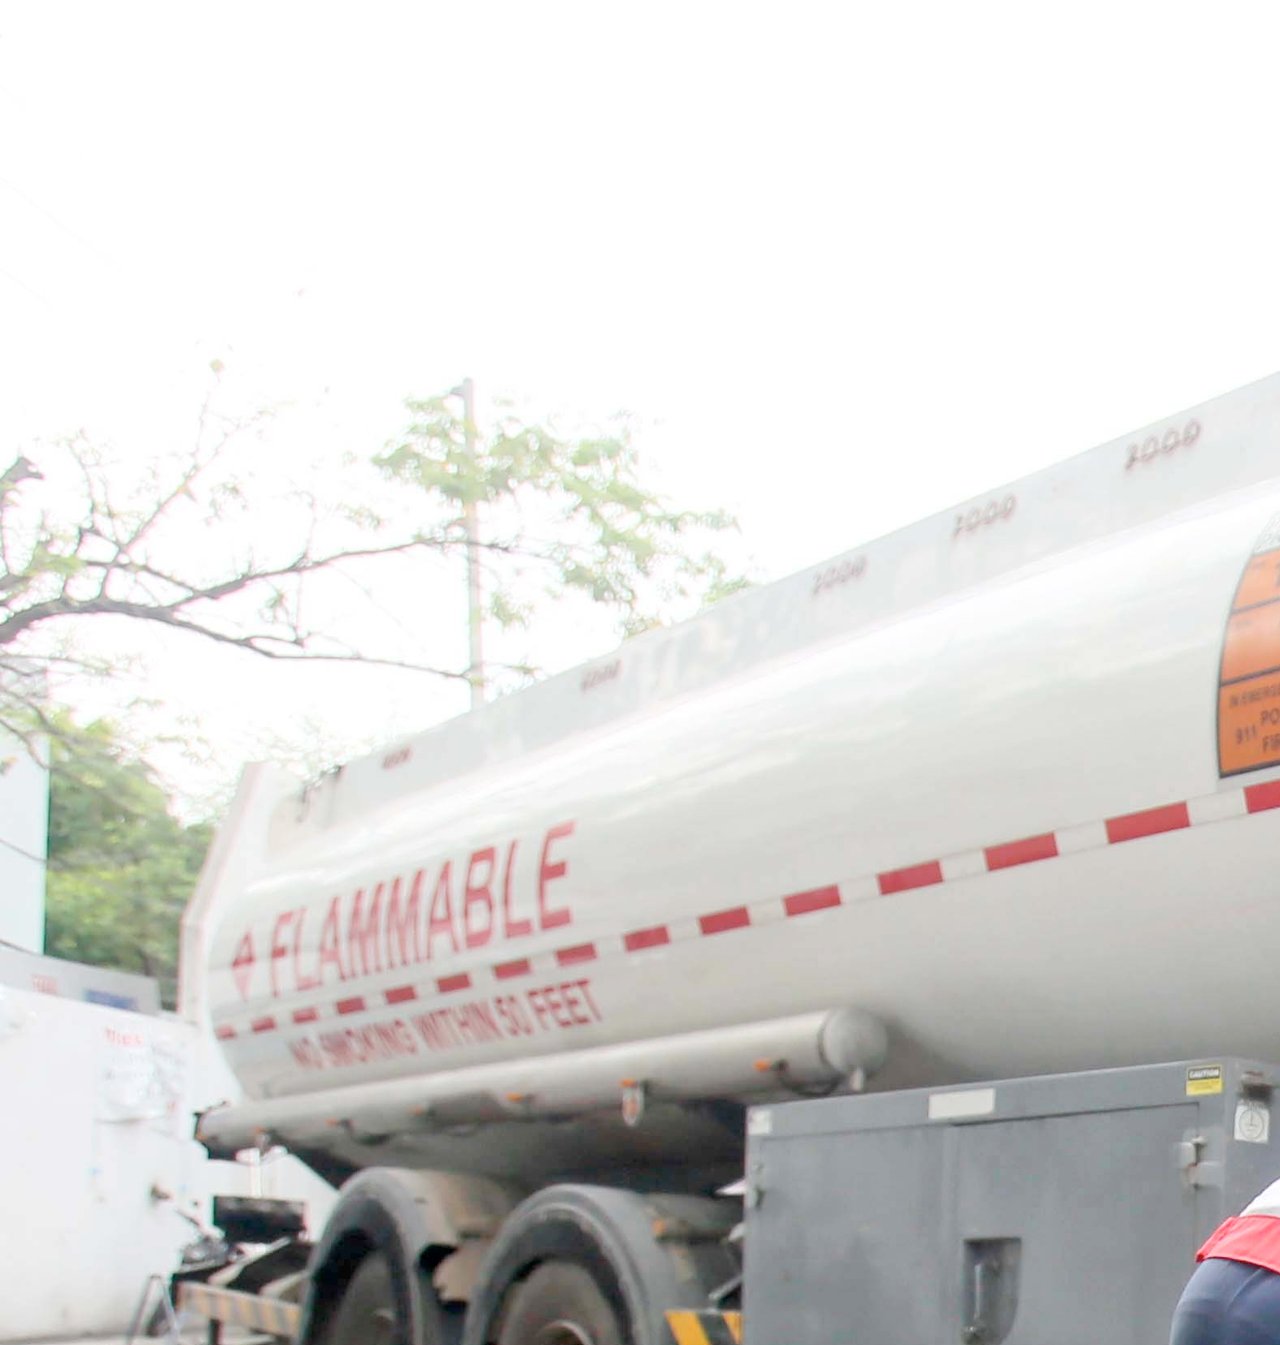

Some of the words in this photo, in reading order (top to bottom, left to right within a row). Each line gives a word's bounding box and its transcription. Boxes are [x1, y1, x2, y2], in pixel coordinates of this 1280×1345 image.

[1235, 725, 1257, 745] 911
[269, 820, 577, 998] FLAMMABLE
[410, 998, 504, 1053] WITHIN
[492, 995, 534, 1037] 50
[525, 977, 603, 1032] FEET
